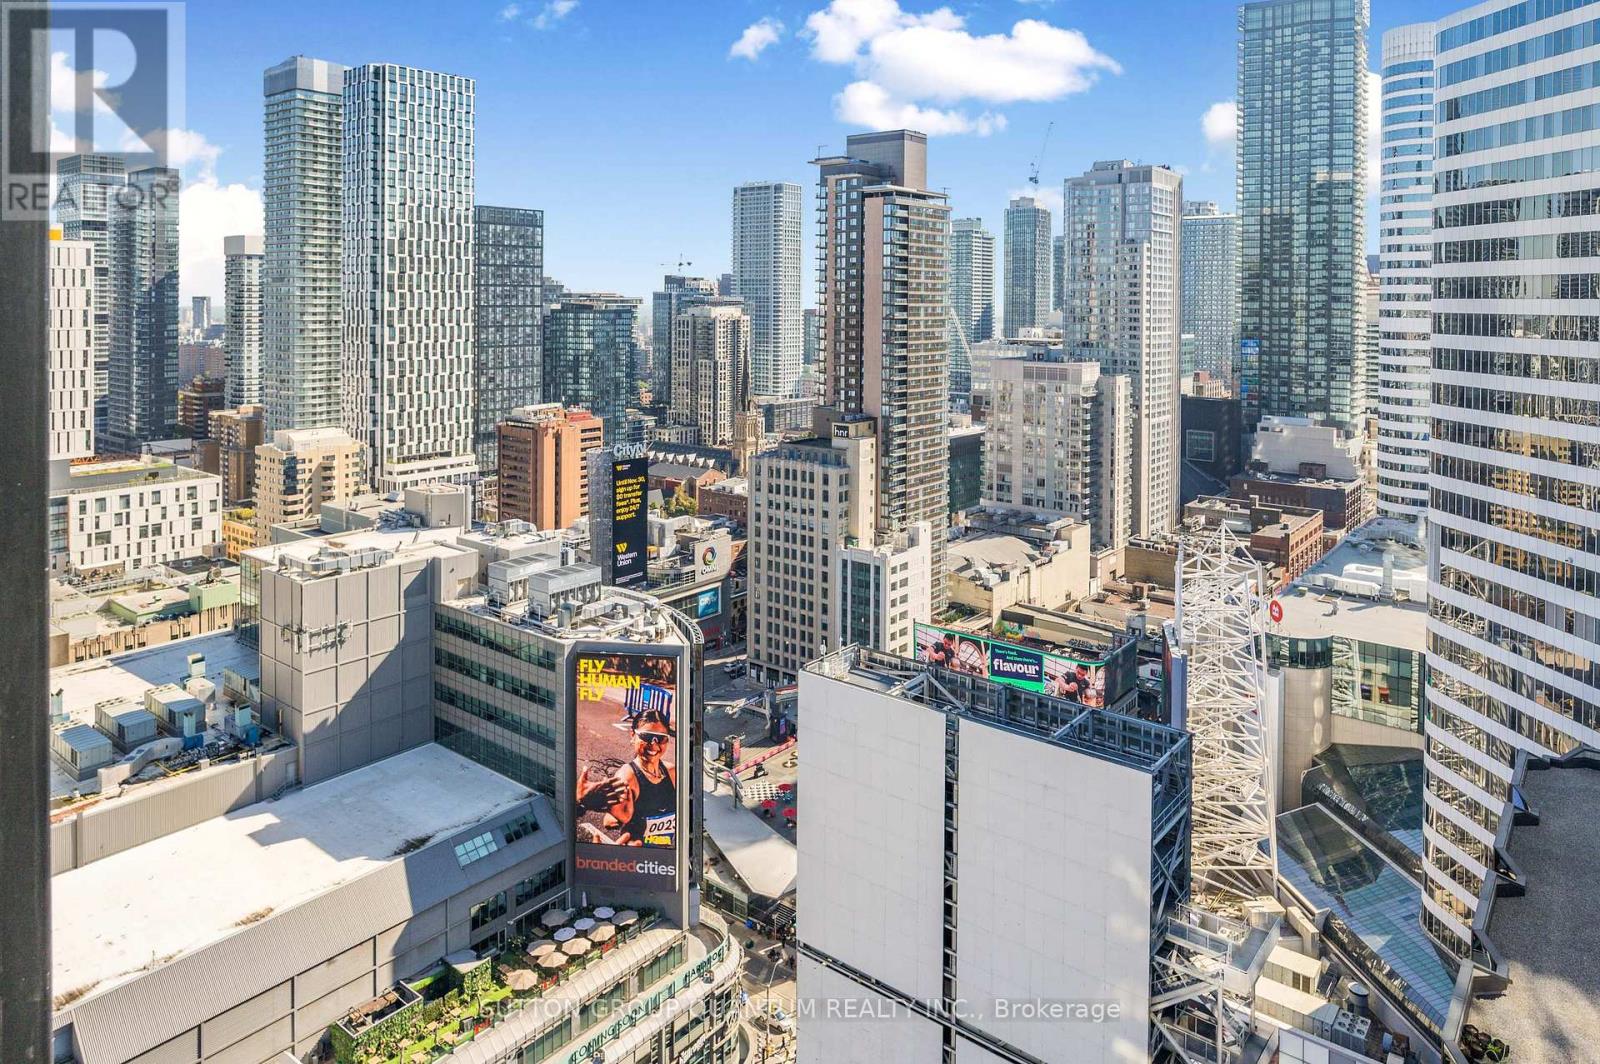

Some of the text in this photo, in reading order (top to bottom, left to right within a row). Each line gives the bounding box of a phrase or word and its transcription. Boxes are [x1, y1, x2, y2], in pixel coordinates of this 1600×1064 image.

[834, 426, 849, 437] hnr
[616, 559, 632, 567] Union
[617, 552, 638, 560] Western
[579, 659, 606, 673] FLY
[994, 658, 1039, 674] flavour
[579, 673, 641, 690] HUMAN
[579, 687, 605, 701] FLY
[576, 856, 676, 876] brandedcities
